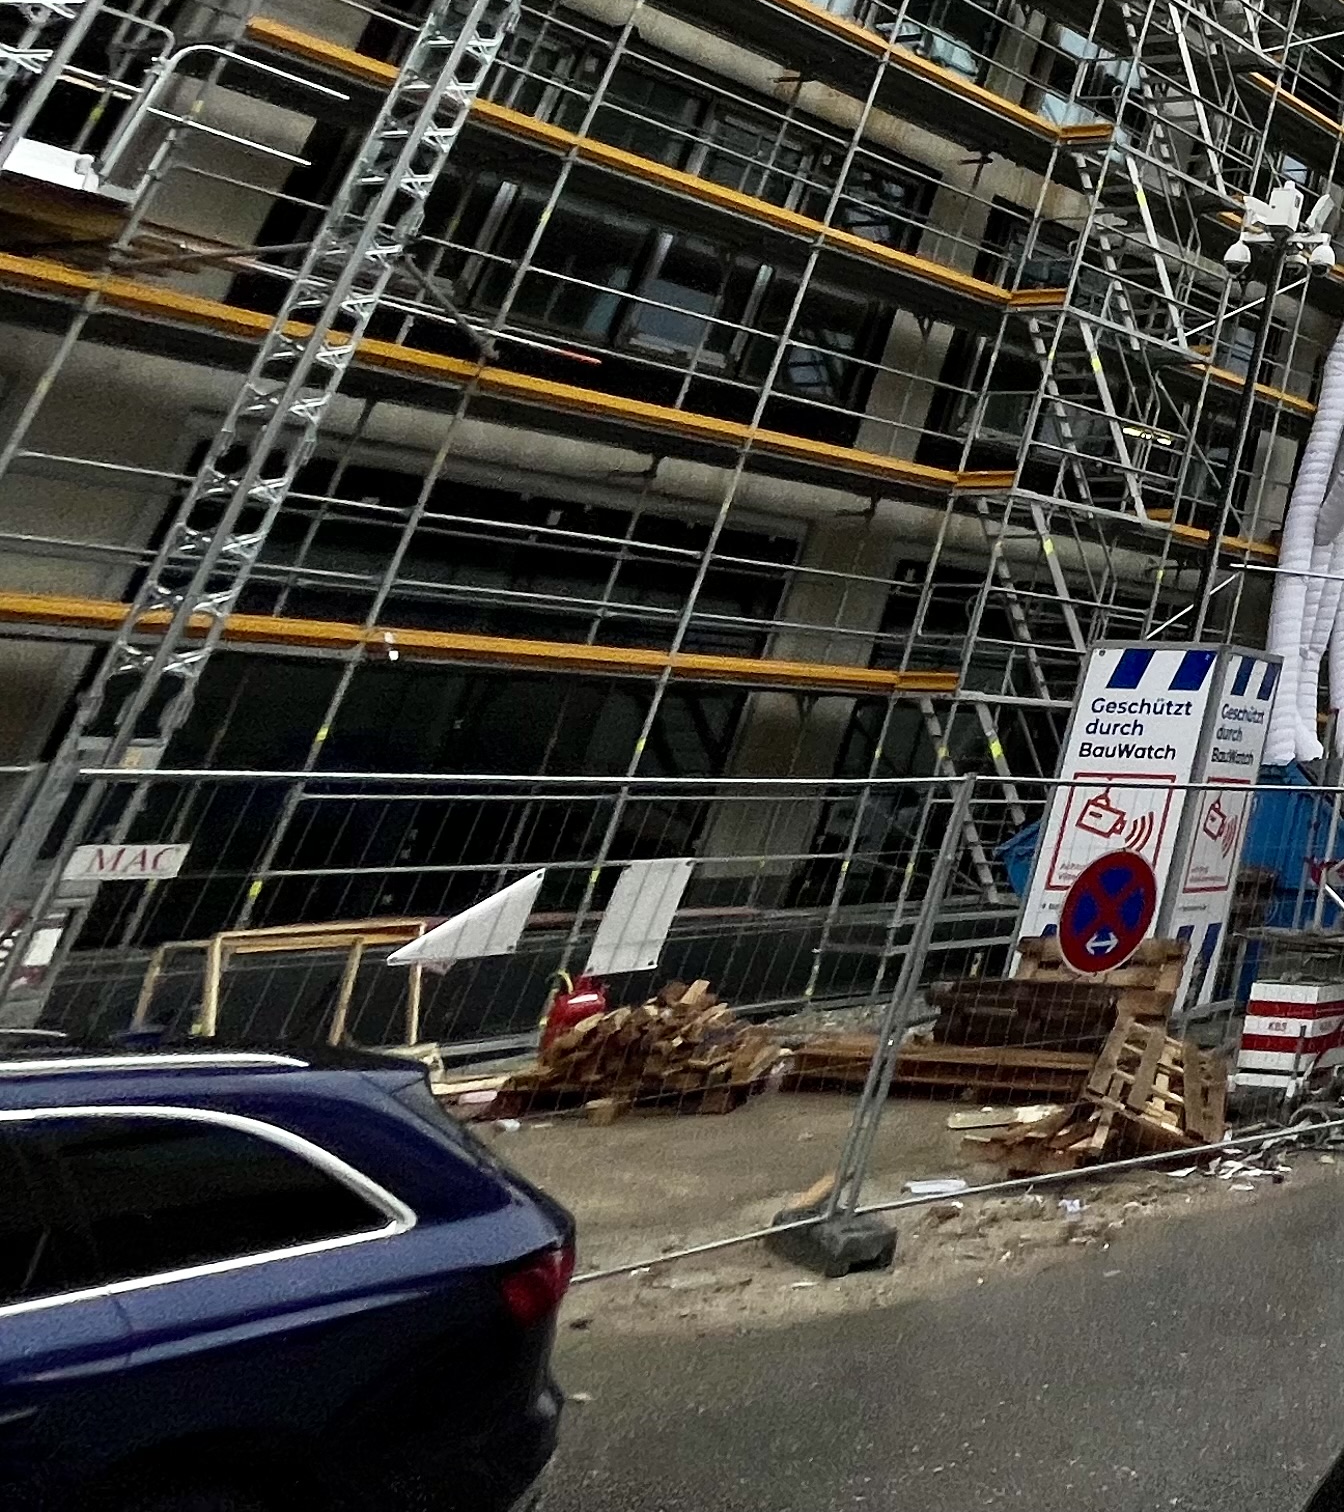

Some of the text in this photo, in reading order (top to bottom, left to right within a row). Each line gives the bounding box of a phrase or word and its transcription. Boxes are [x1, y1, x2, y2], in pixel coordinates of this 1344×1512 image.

[1091, 697, 1193, 716] Geschützt
[1085, 718, 1144, 736] durch
[1078, 742, 1176, 760] BauWatch
[85, 846, 176, 873] MAC
